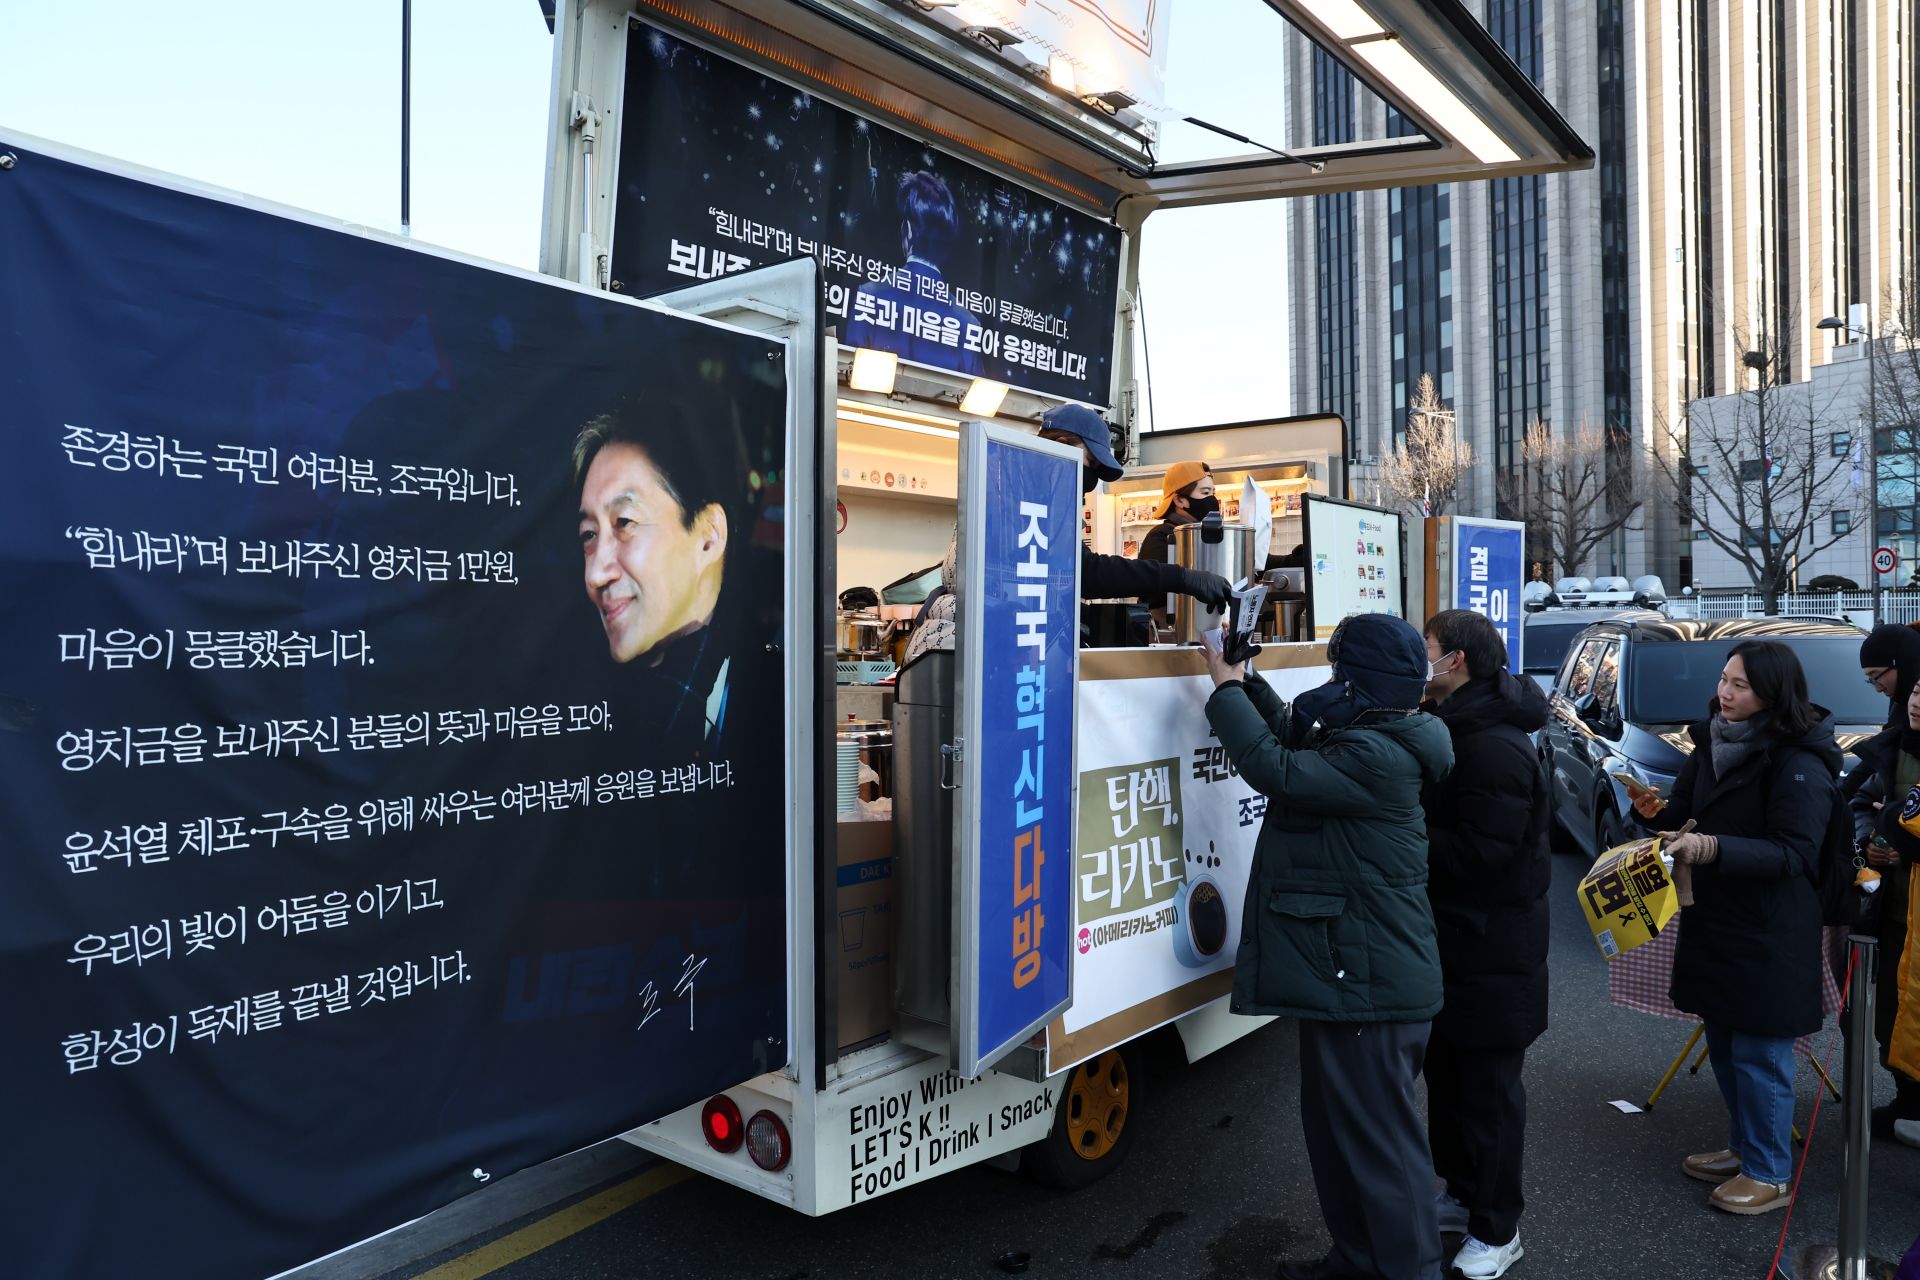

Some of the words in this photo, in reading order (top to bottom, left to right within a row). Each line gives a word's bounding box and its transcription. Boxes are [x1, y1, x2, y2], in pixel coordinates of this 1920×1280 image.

[667, 238, 751, 280] 보내
[854, 291, 898, 331] 뜻과
[903, 304, 961, 348] 마음을
[964, 322, 1000, 358] 모아
[1003, 334, 1087, 381] 응원합니다!
[866, 258, 912, 292] 영치금
[916, 274, 952, 306] 1만원,
[956, 287, 996, 317] 마음이
[1000, 300, 1070, 340] 뭉클했습니다.
[61, 423, 207, 479] 존경하는
[211, 443, 279, 485] 국민
[288, 453, 383, 496] 여러분,
[389, 463, 521, 507] 조국입니다.
[236, 540, 361, 580] 보내주신
[368, 544, 452, 583] 영치금
[457, 549, 520, 586] 1만원,
[1877, 555, 1891, 566] 40
[58, 627, 175, 671] 마음이
[184, 629, 376, 669] 뭉클했습니다.
[56, 722, 208, 772] 영치금을
[212, 715, 339, 758] 보내주신
[346, 710, 430, 750] 분들의
[436, 708, 491, 749] 뜻과
[494, 702, 563, 740] 마음을
[566, 700, 614, 733] 모아,
[62, 821, 170, 874] 윤석열
[356, 796, 414, 837] 위해
[420, 790, 497, 827] 싸우는
[501, 775, 590, 817] 여러분께
[594, 767, 657, 805] 응원을
[660, 759, 735, 796] 보냅니다.
[1081, 836, 1184, 909] 리카노
[67, 919, 172, 976] 우리의
[179, 906, 247, 956] 빛이
[257, 890, 352, 937] 어둠을
[1077, 933, 1092, 949] hot
[61, 1015, 178, 1074] 함성이
[188, 989, 285, 1044] 독재를
[288, 975, 352, 1022] 끝낼
[356, 950, 472, 1007] 것입니다.
[850, 1090, 912, 1135] Enjoy
[851, 1121, 912, 1171] LET'S
[919, 1111, 932, 1141] K
[851, 1154, 906, 1204] Food
[929, 1122, 979, 1166] Drink
[1001, 1088, 1053, 1131] Snack
